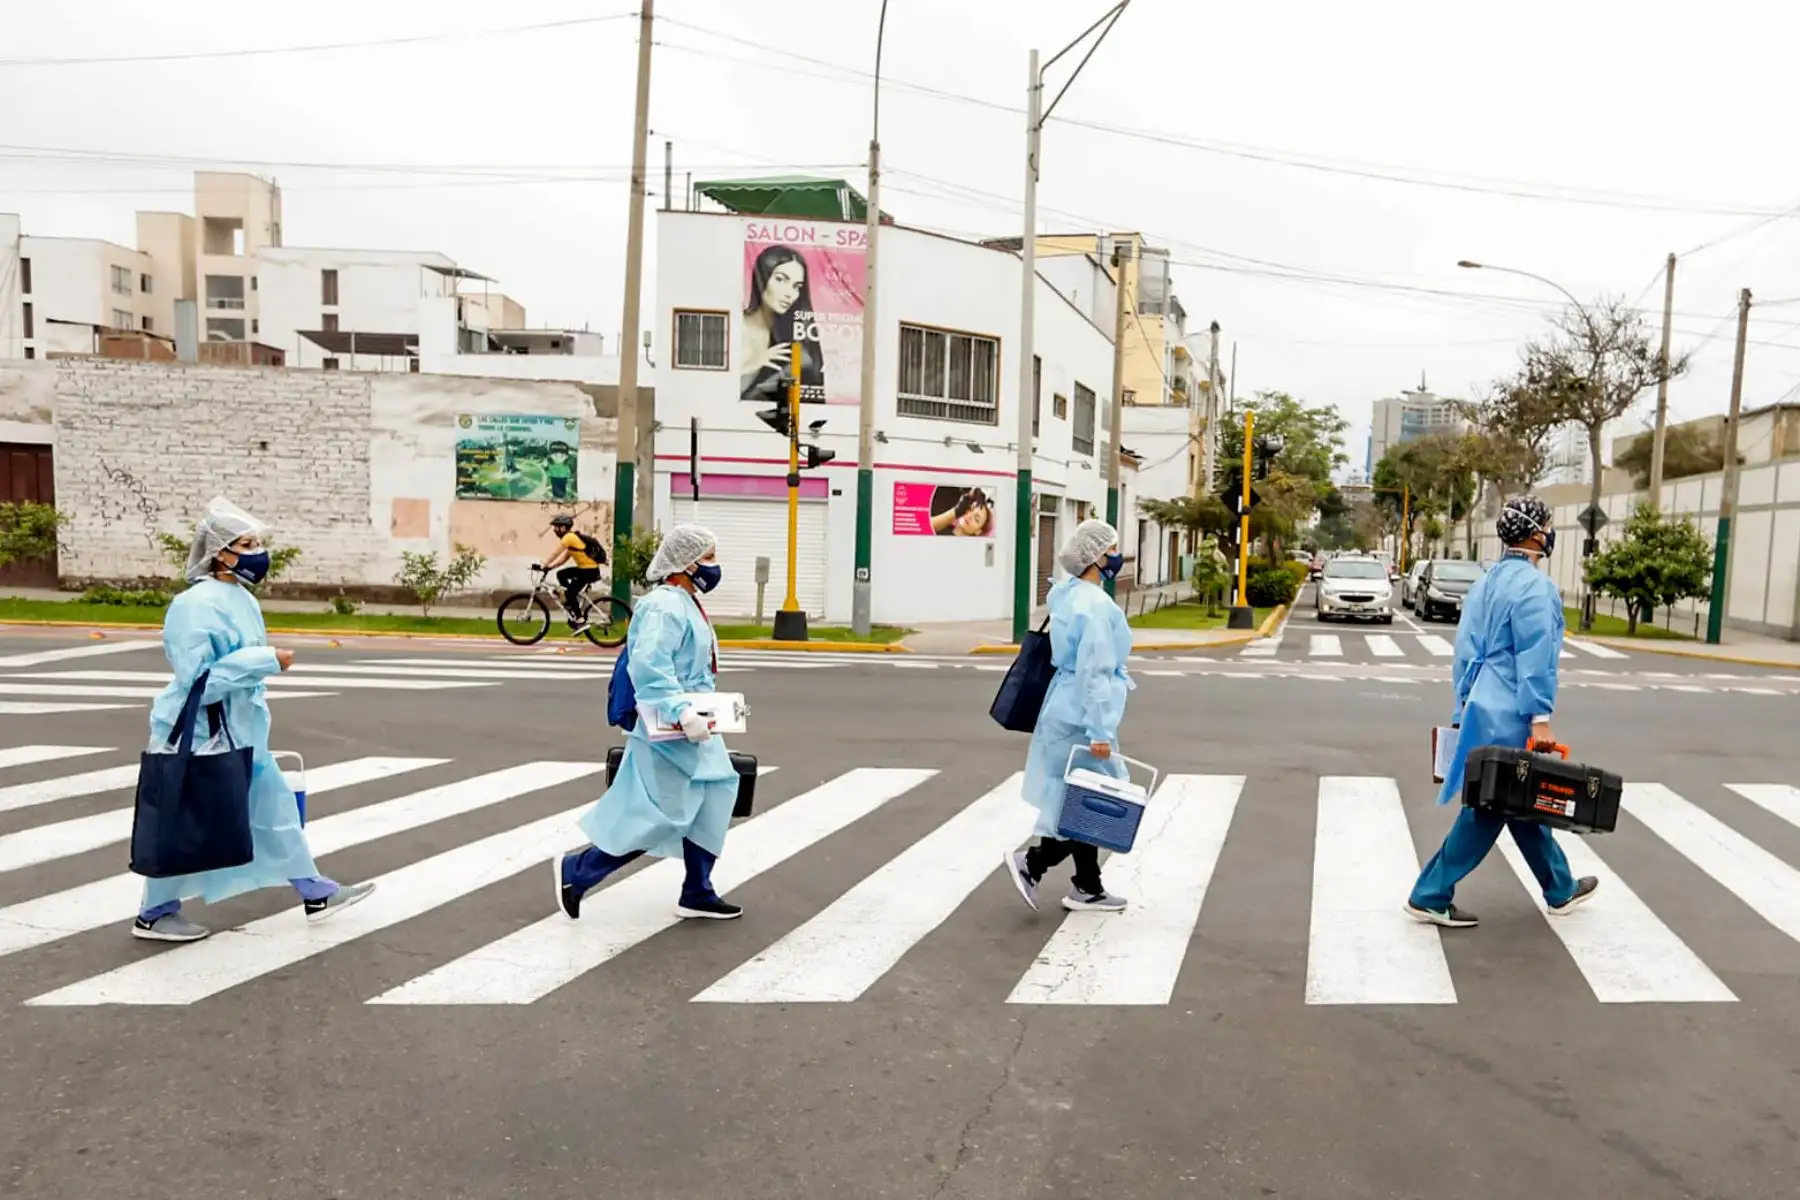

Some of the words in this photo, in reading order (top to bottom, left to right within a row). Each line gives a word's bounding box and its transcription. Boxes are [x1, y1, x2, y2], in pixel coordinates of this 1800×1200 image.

[748, 223, 815, 242] SALON
[836, 229, 867, 247] SPA
[794, 310, 825, 321] SUPER
